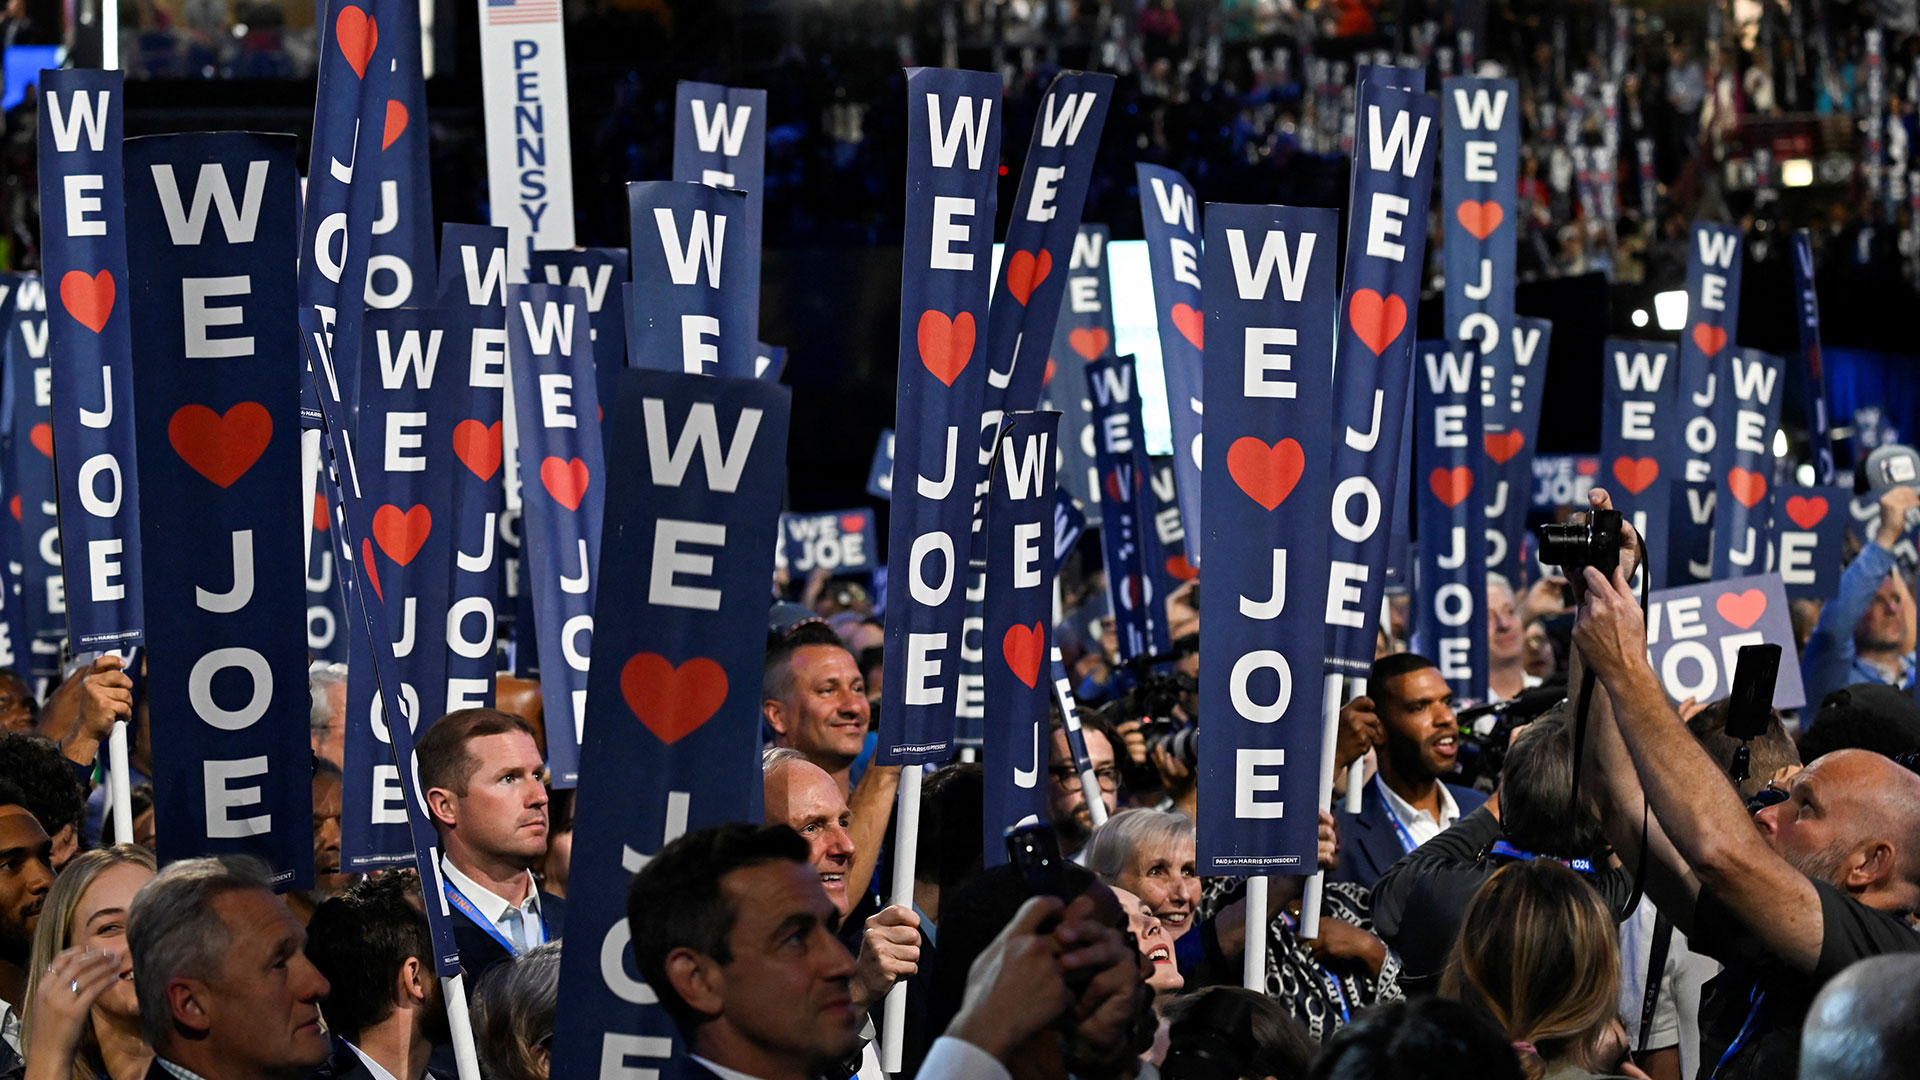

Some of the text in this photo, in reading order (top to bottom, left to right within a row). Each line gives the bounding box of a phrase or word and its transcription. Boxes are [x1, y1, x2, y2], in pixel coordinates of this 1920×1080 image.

[513, 40, 548, 283] PENNSY
[1027, 92, 1097, 223] WE
[1454, 89, 1509, 183] WE
[363, 180, 413, 309] JO
[1151, 178, 1202, 290] WE
[1697, 229, 1737, 312] WE
[46, 90, 125, 602] WE JOE
[520, 301, 577, 429] WE
[905, 93, 993, 706] WE JOE
[1092, 364, 1134, 454] WE
[1325, 104, 1432, 629] WE JOE
[1614, 352, 1668, 441] WE
[1732, 357, 1777, 455] WE
[1531, 457, 1573, 477] WE
[1533, 476, 1595, 505] JOE
[1685, 373, 1717, 482] JOE
[151, 160, 274, 838] WE JOE
[643, 398, 763, 611] WE
[788, 515, 838, 541] WE
[794, 533, 867, 571] JOE
[1003, 432, 1049, 588] WE
[1226, 229, 1317, 819] WE JOE
[1424, 351, 1475, 681] WE JOE
[370, 329, 444, 826] WE JOE
